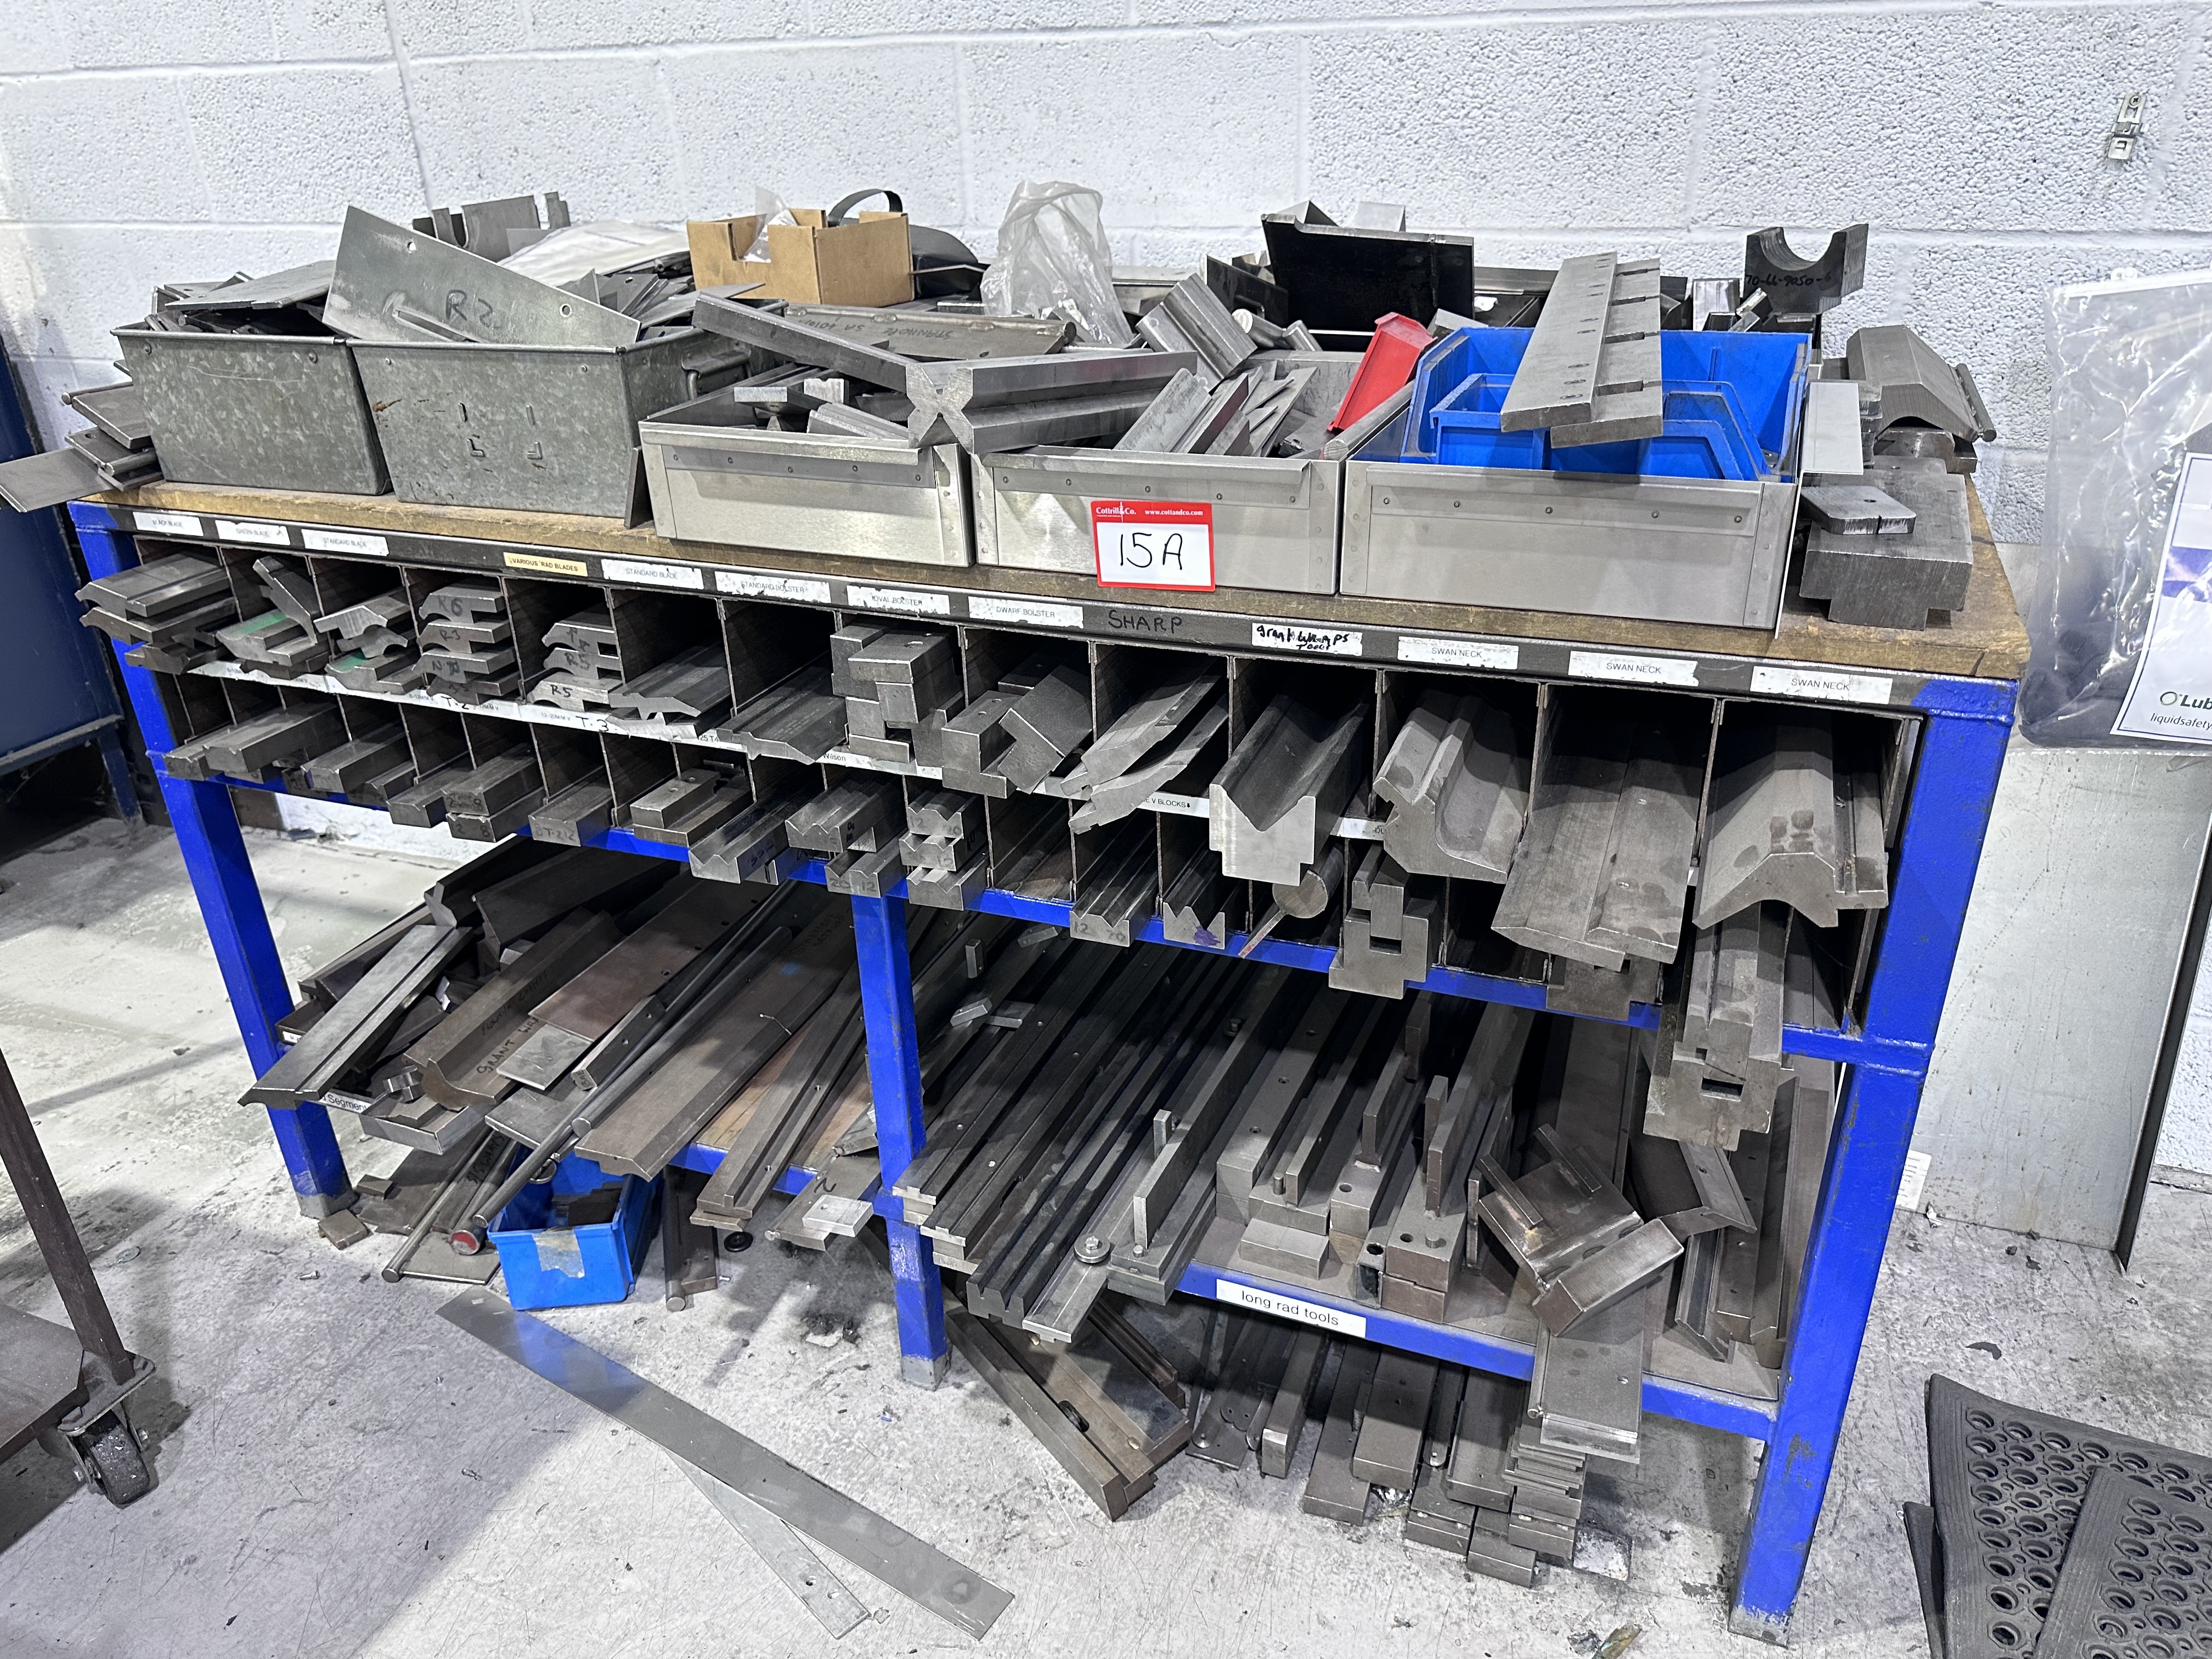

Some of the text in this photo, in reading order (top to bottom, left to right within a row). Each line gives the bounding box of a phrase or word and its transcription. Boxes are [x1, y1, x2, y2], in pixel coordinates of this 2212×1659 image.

[1120, 532, 1183, 570] 15A
[512, 558, 538, 566] VARIOUS
[555, 563, 578, 572] BLADES
[626, 568, 658, 577] STANDARD
[741, 580, 805, 594] STANDARD BOLSTER
[891, 597, 923, 606] BOLSTER
[996, 606, 1056, 618] DWARF BOLSTER
[1108, 610, 1182, 634] SHARP
[1431, 647, 1483, 659] SWAN NECK
[1606, 661, 1662, 675] SWAN NECK
[550, 685, 573, 698] R5
[1791, 678, 1850, 692] SWAN NECK
[1158, 799, 1186, 808] BLOCKS
[1242, 1290, 1339, 1325] long rad tools
